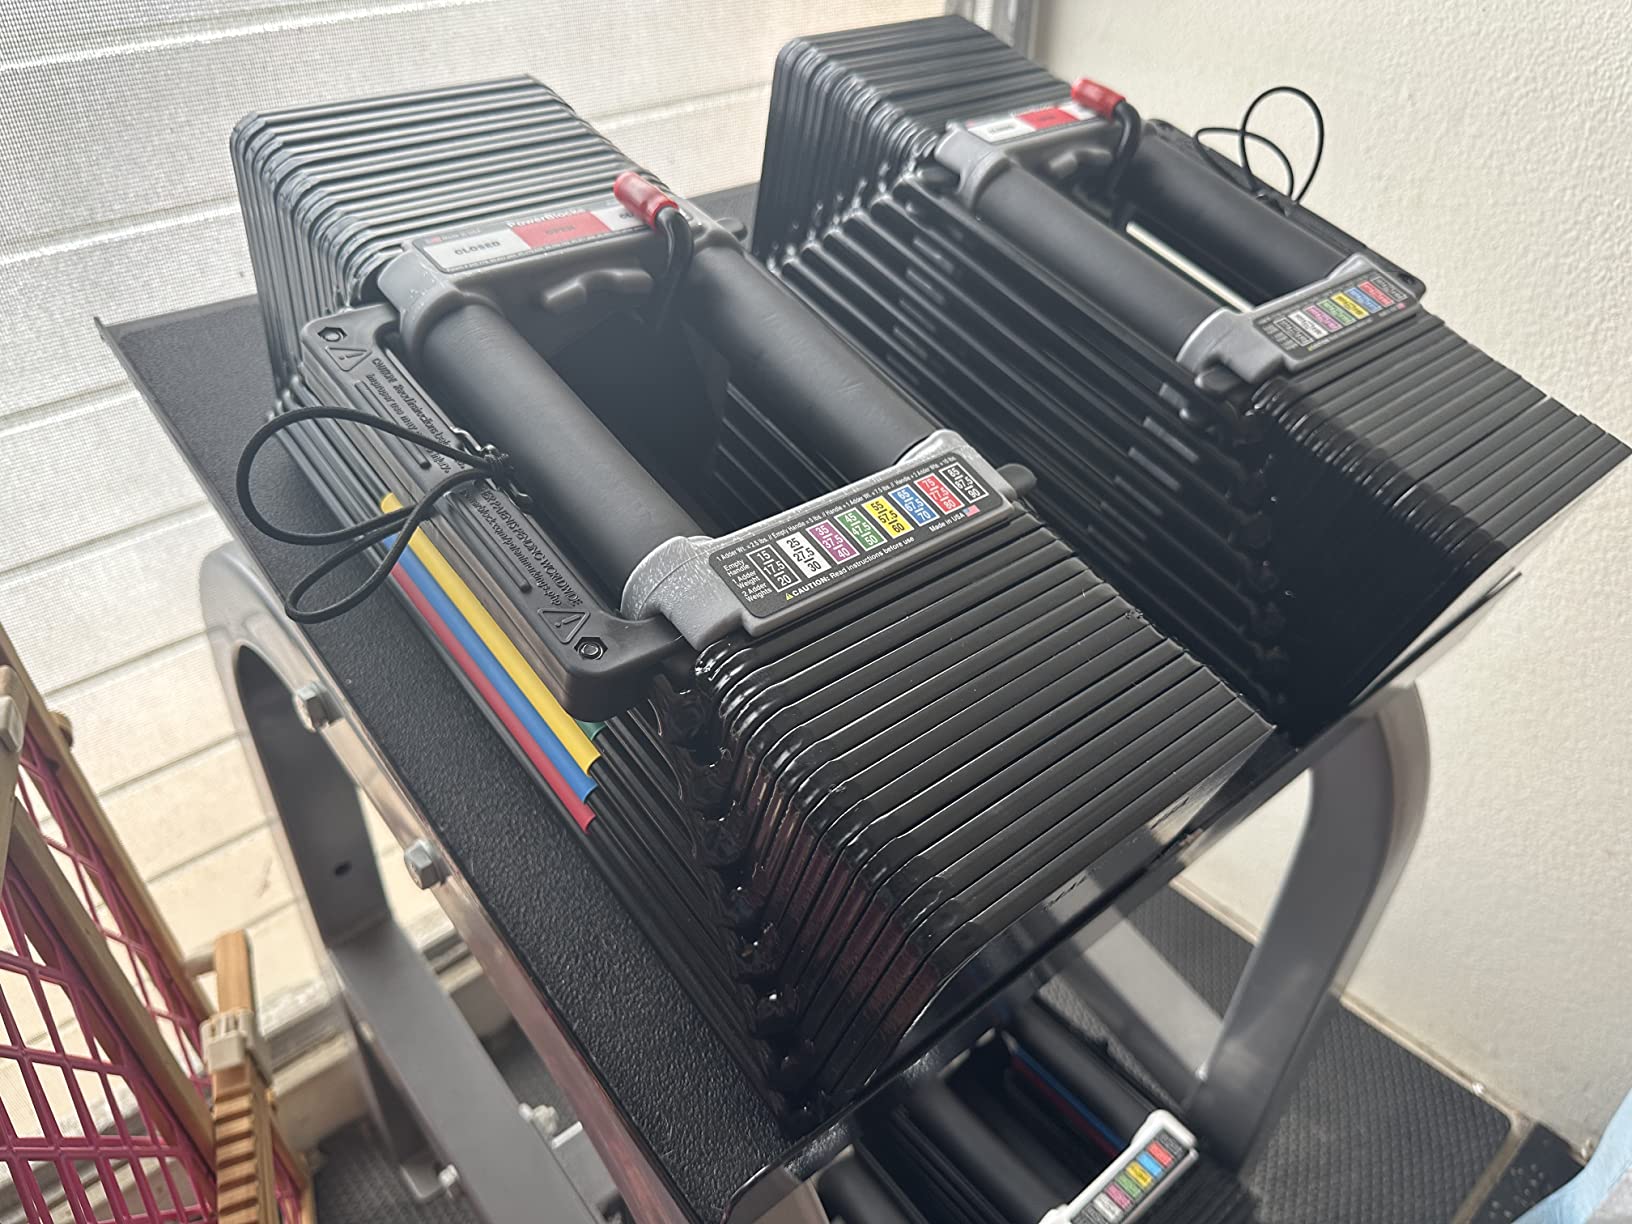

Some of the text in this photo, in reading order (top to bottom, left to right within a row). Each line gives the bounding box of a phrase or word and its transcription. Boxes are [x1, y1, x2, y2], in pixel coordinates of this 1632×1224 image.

[454, 241, 500, 255] CLOSED
[946, 467, 960, 477] 85
[921, 478, 934, 488] 75
[897, 488, 910, 499] 65
[929, 487, 949, 500] 77.5
[967, 488, 980, 498] 90
[870, 500, 884, 511] 55
[904, 498, 924, 511] 67.5
[942, 499, 956, 509] 80
[843, 512, 857, 523] 45
[877, 509, 898, 523] 57.5
[917, 510, 931, 521] 70
[928, 520, 946, 532] Made
[951, 511, 965, 521] USA
[814, 524, 829, 535] 35
[851, 521, 871, 535] 47.5
[891, 522, 905, 533] 60
[785, 537, 800, 548] 25
[822, 534, 844, 548] 37.5
[864, 534, 878, 545] 50
[756, 550, 771, 561] 15
[792, 547, 814, 562] 27.5
[836, 547, 850, 558] 40
[512, 528, 545, 561] PENDING
[539, 559, 582, 606] WORLDWIDE
[722, 558, 744, 572] Empty
[726, 563, 750, 577] Handle
[763, 560, 785, 575] 17.5
[791, 536, 915, 597] CAUTION: Read instructions before use
[806, 560, 821, 572] 30
[736, 569, 756, 581] Adder
[776, 574, 792, 586] 20
[736, 575, 761, 590] Weight
[747, 582, 767, 594] Adder
[745, 587, 773, 603] Weights
